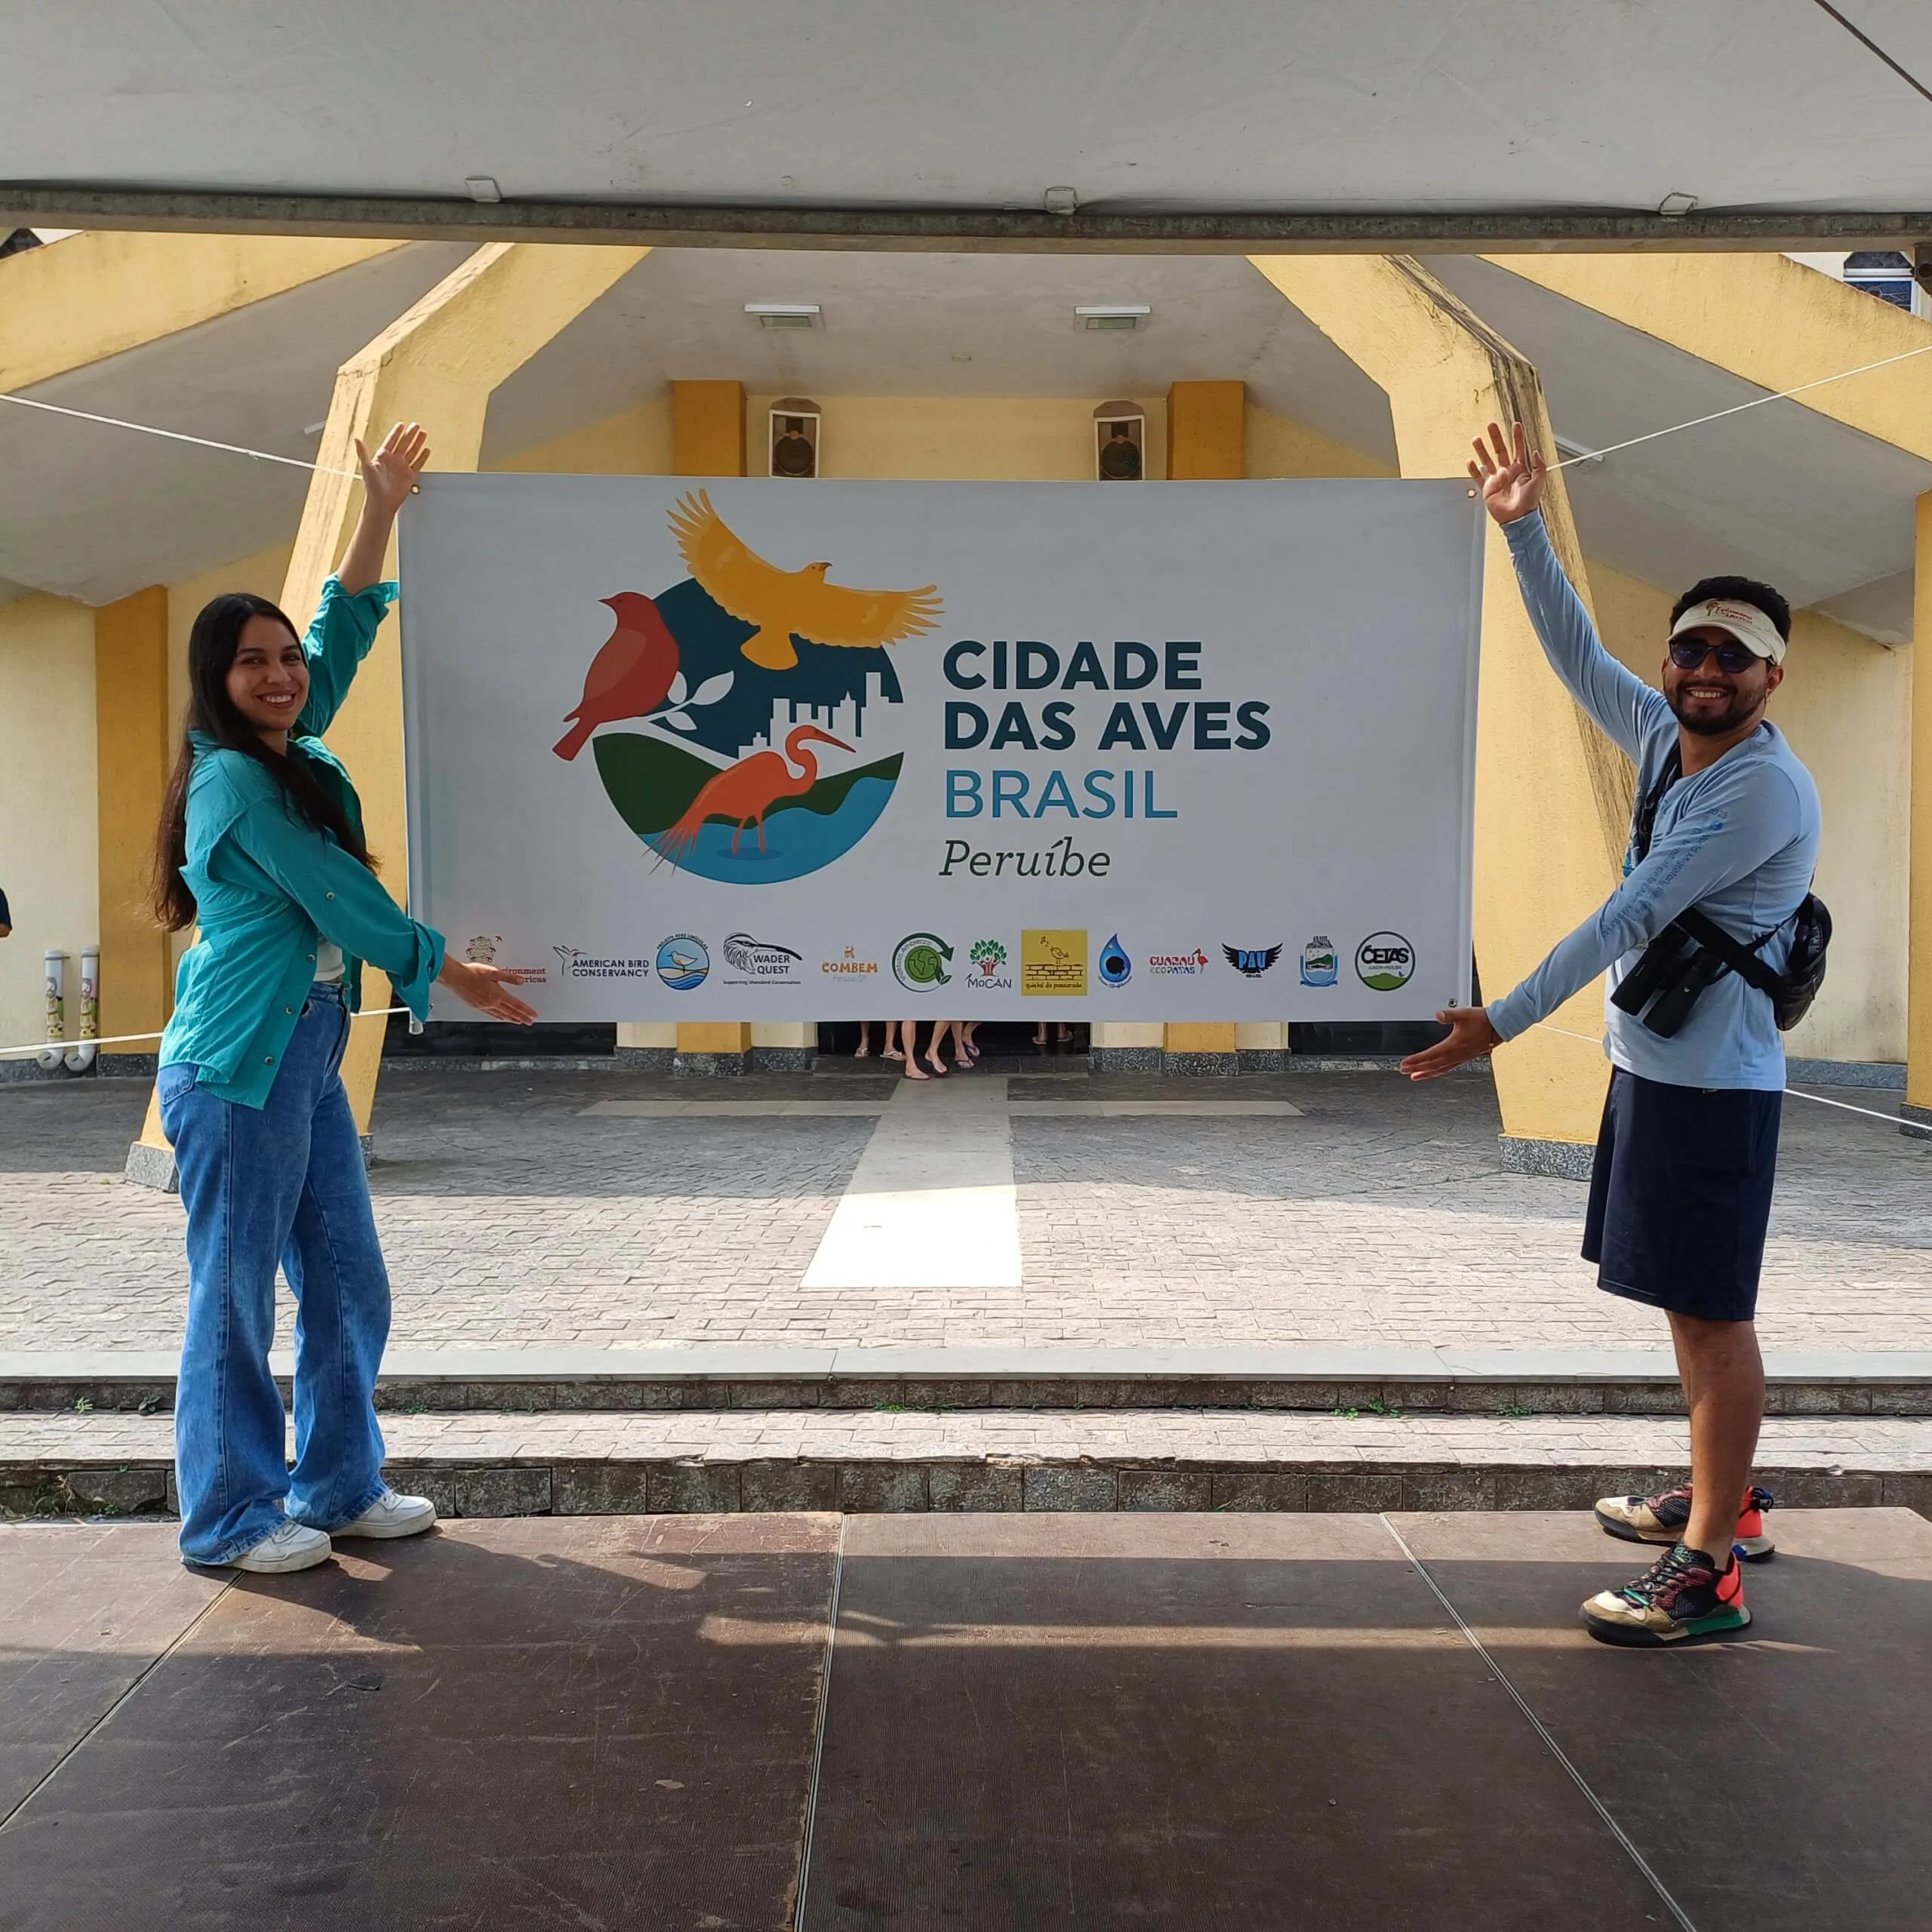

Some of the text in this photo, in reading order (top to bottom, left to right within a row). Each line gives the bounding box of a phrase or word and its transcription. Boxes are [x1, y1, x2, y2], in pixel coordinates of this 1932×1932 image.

[943, 640, 1202, 690] CIDADE
[944, 701, 1271, 750] DAS AVES
[946, 770, 1178, 819] BRASIL
[939, 836, 1110, 877] Peruíbe
[572, 959, 650, 968] AMERICAN BIRD
[753, 955, 790, 963] WADER
[501, 967, 546, 975] ironment
[572, 968, 649, 977] CONSERVANCY
[757, 965, 790, 975] QUEST
[821, 962, 878, 973] COMBEM
[524, 975, 546, 983] ricas
